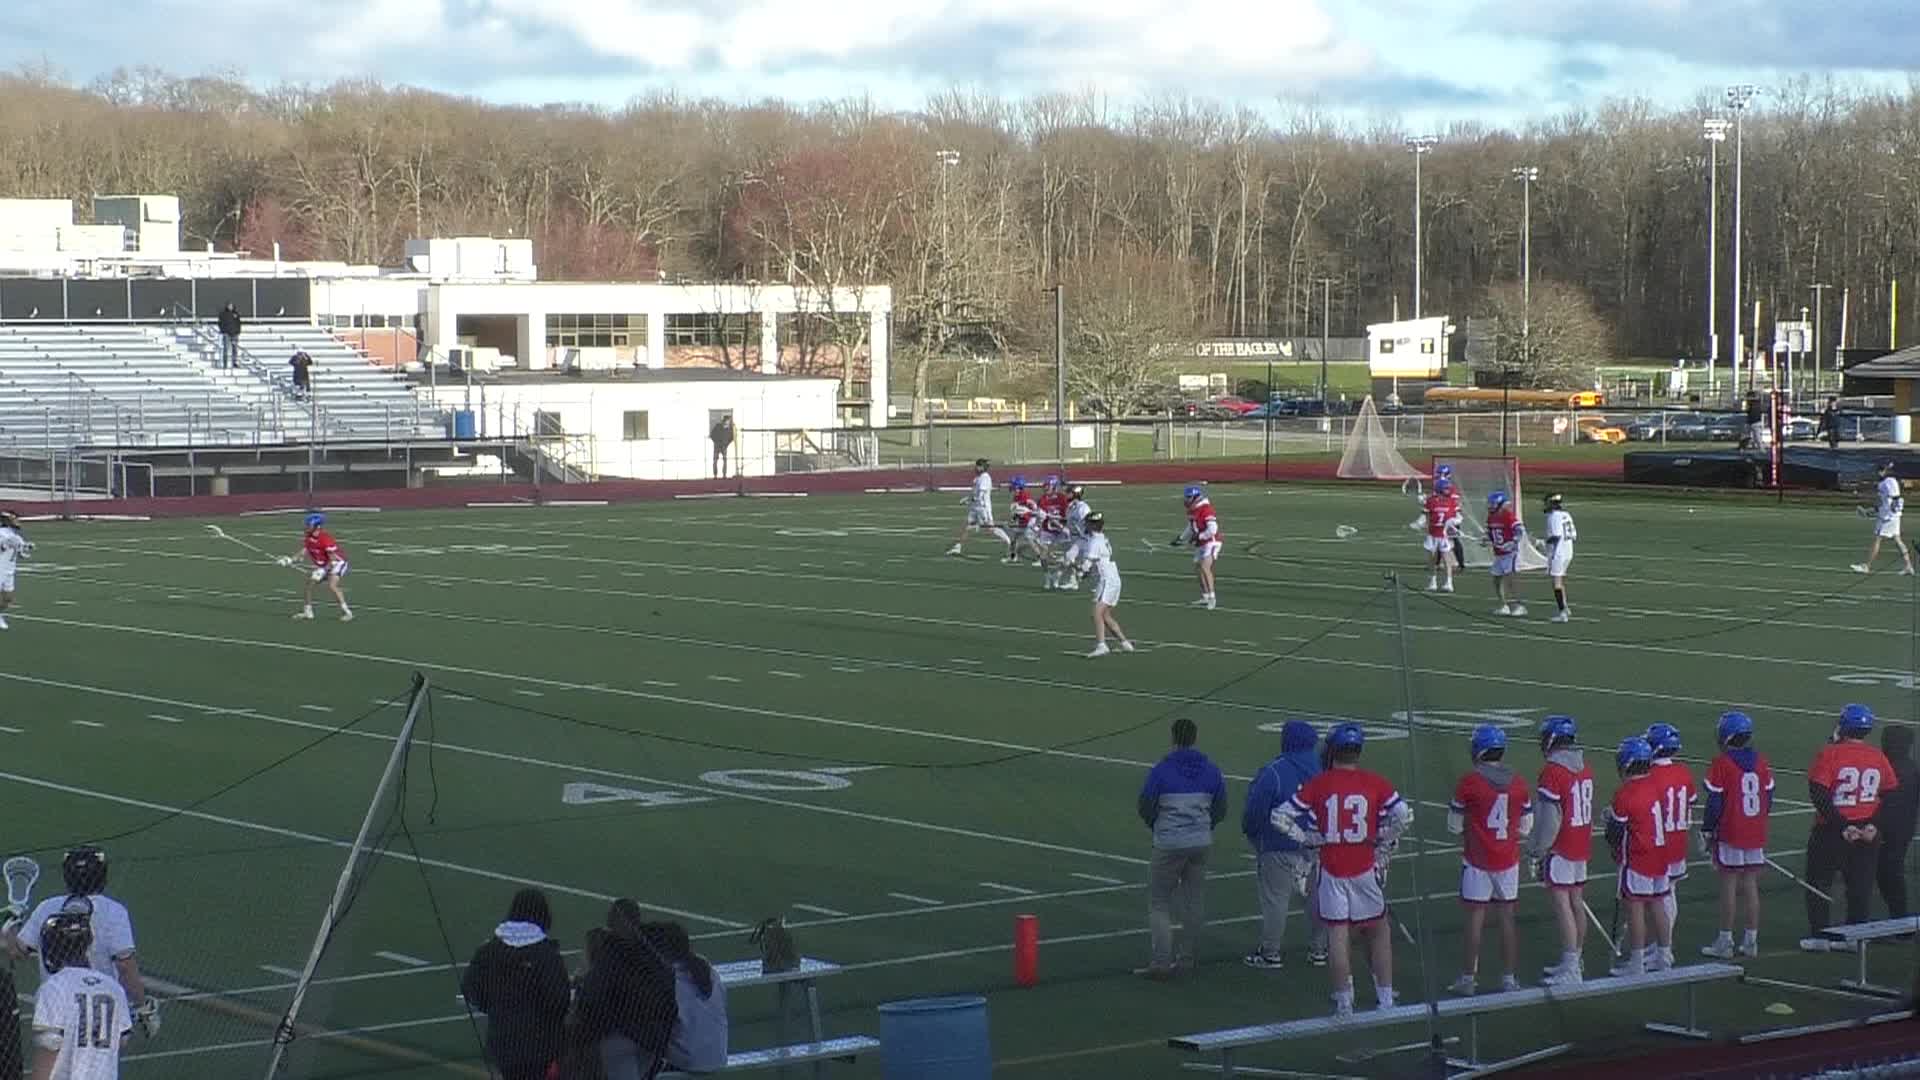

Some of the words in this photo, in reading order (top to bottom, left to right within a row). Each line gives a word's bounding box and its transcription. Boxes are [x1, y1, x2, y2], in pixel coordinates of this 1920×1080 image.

[1196, 342, 1211, 356] OF
[1211, 342, 1236, 356] THE
[1236, 342, 1280, 356] EAGLES
[1570, 778, 1593, 826] 18
[1741, 771, 1761, 817] 8
[1833, 766, 1881, 806] 29
[1325, 793, 1368, 843] 13
[1487, 793, 1508, 840] 4
[74, 992, 116, 1049] 10
